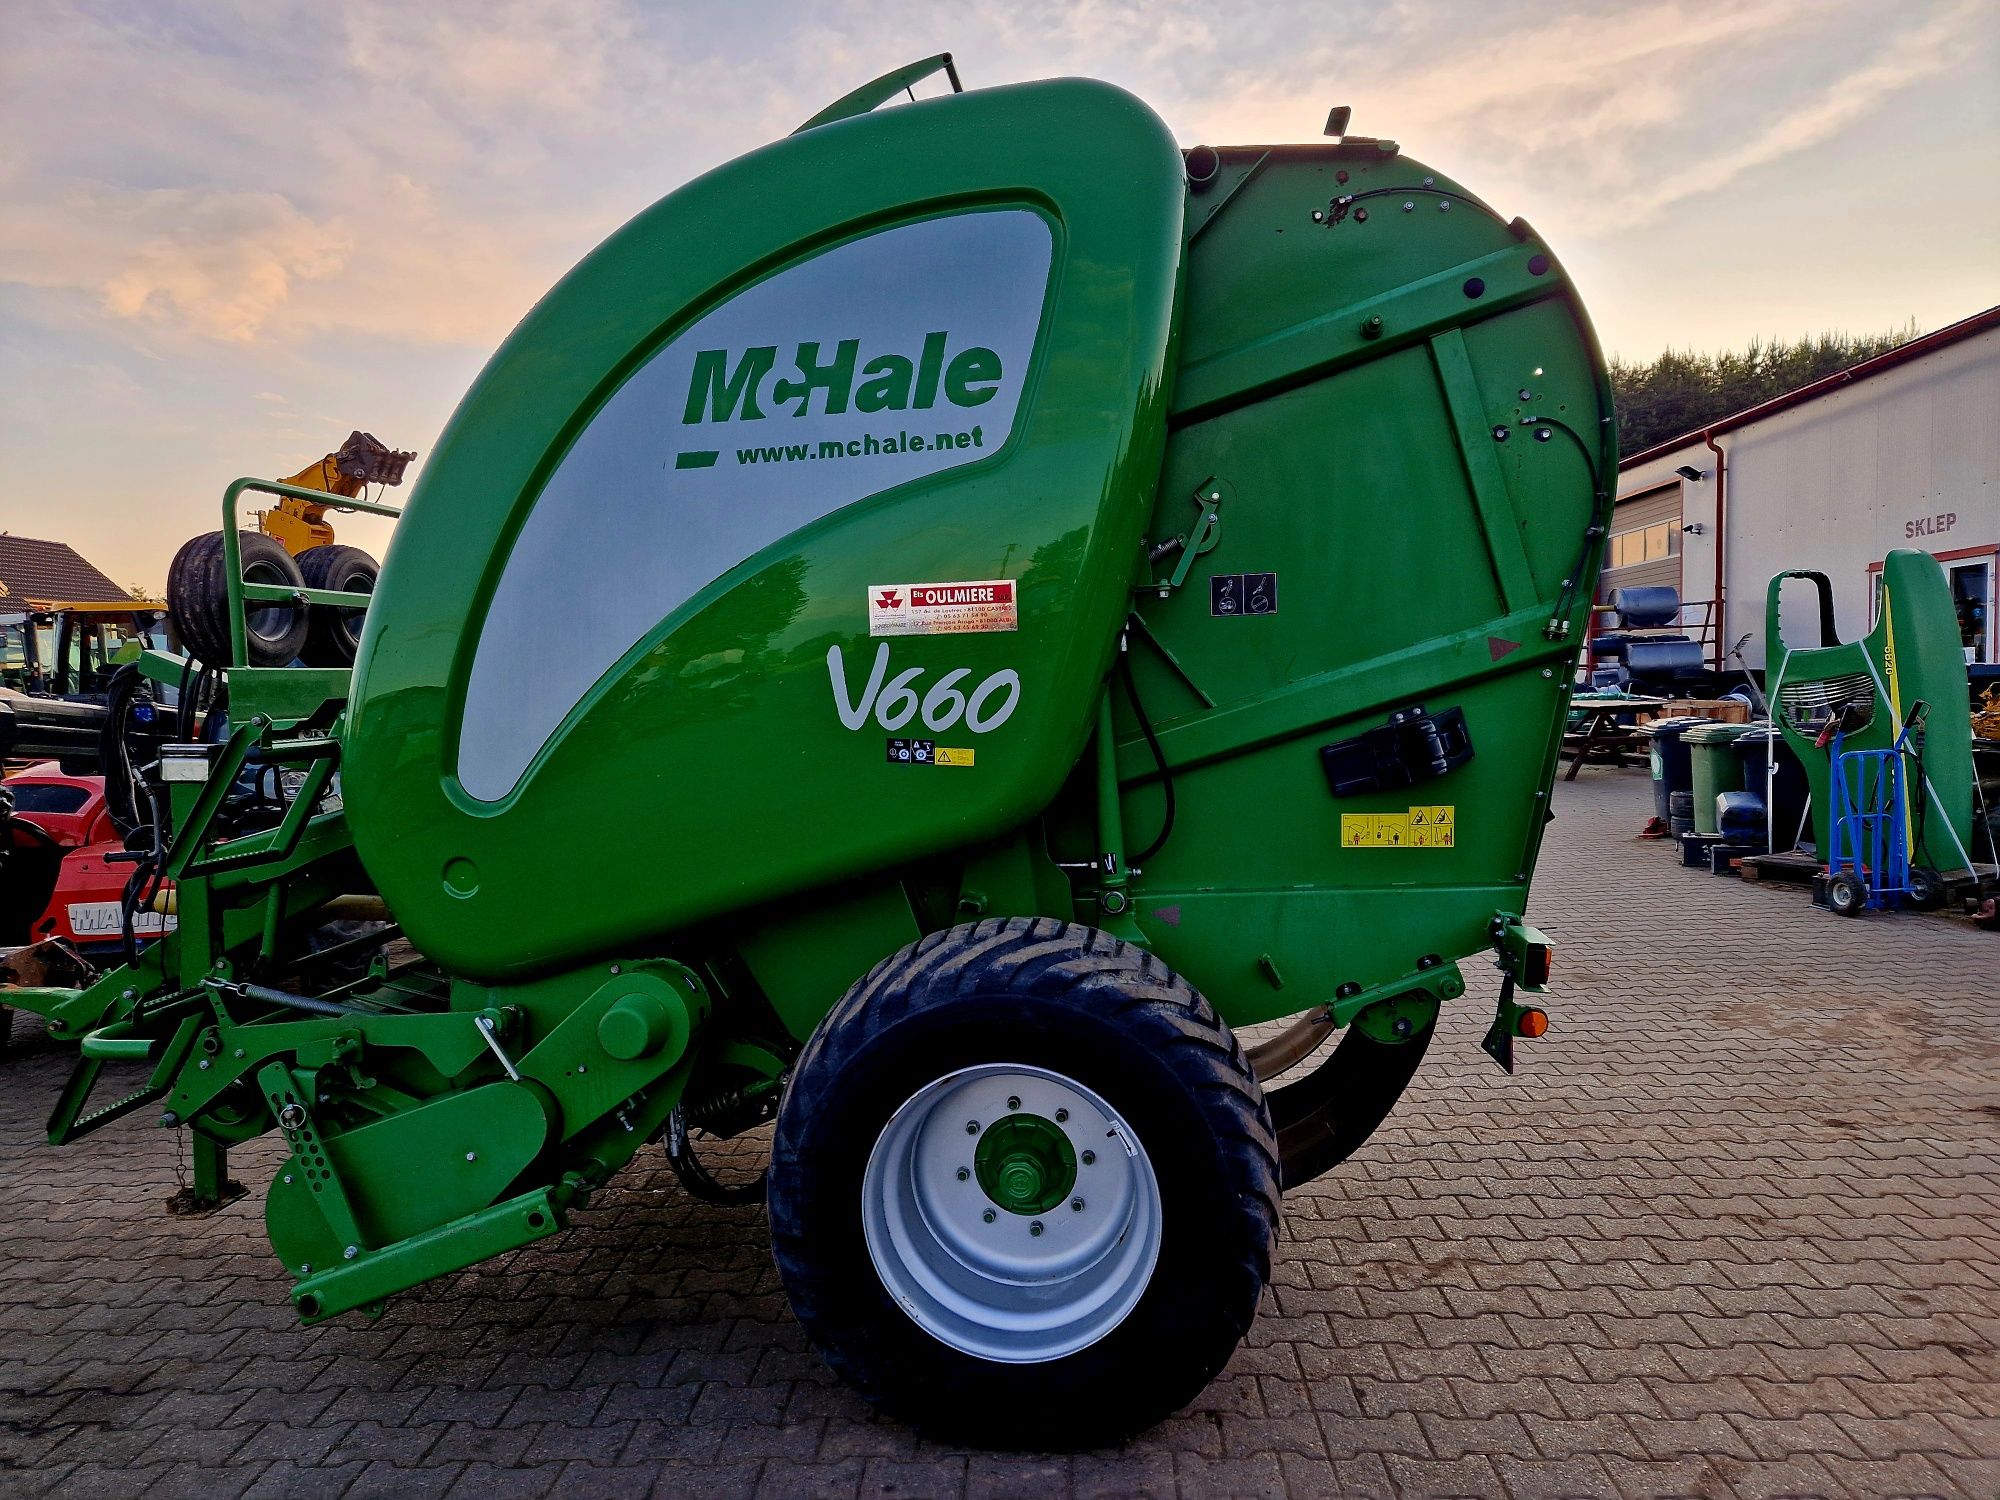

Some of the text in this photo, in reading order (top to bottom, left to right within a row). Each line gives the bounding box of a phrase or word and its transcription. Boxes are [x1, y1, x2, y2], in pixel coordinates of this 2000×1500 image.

[737, 425, 983, 465] www.mchale.net
[1905, 513, 1957, 538] SKLEP
[827, 642, 1020, 734] V660
